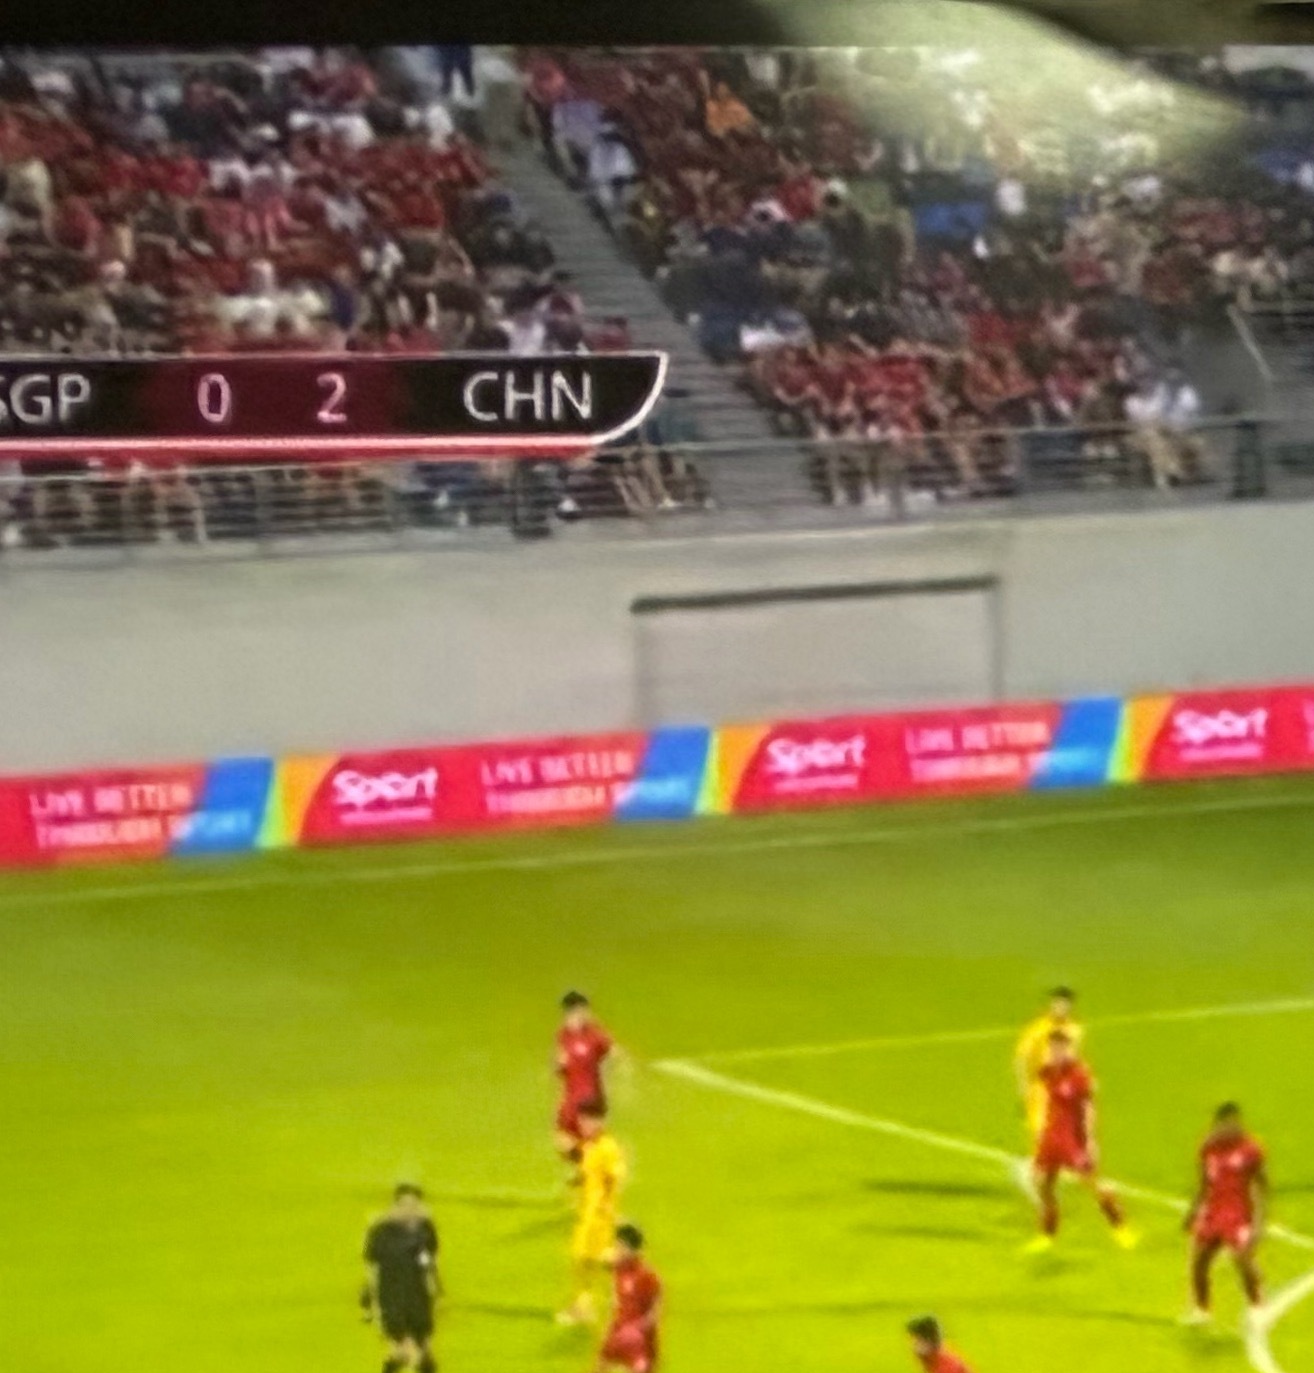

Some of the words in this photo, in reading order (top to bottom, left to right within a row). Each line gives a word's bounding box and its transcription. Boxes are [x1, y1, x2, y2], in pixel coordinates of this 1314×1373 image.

[198, 373, 232, 423] 0
[316, 373, 348, 423] 2
[463, 371, 593, 422] CHN
